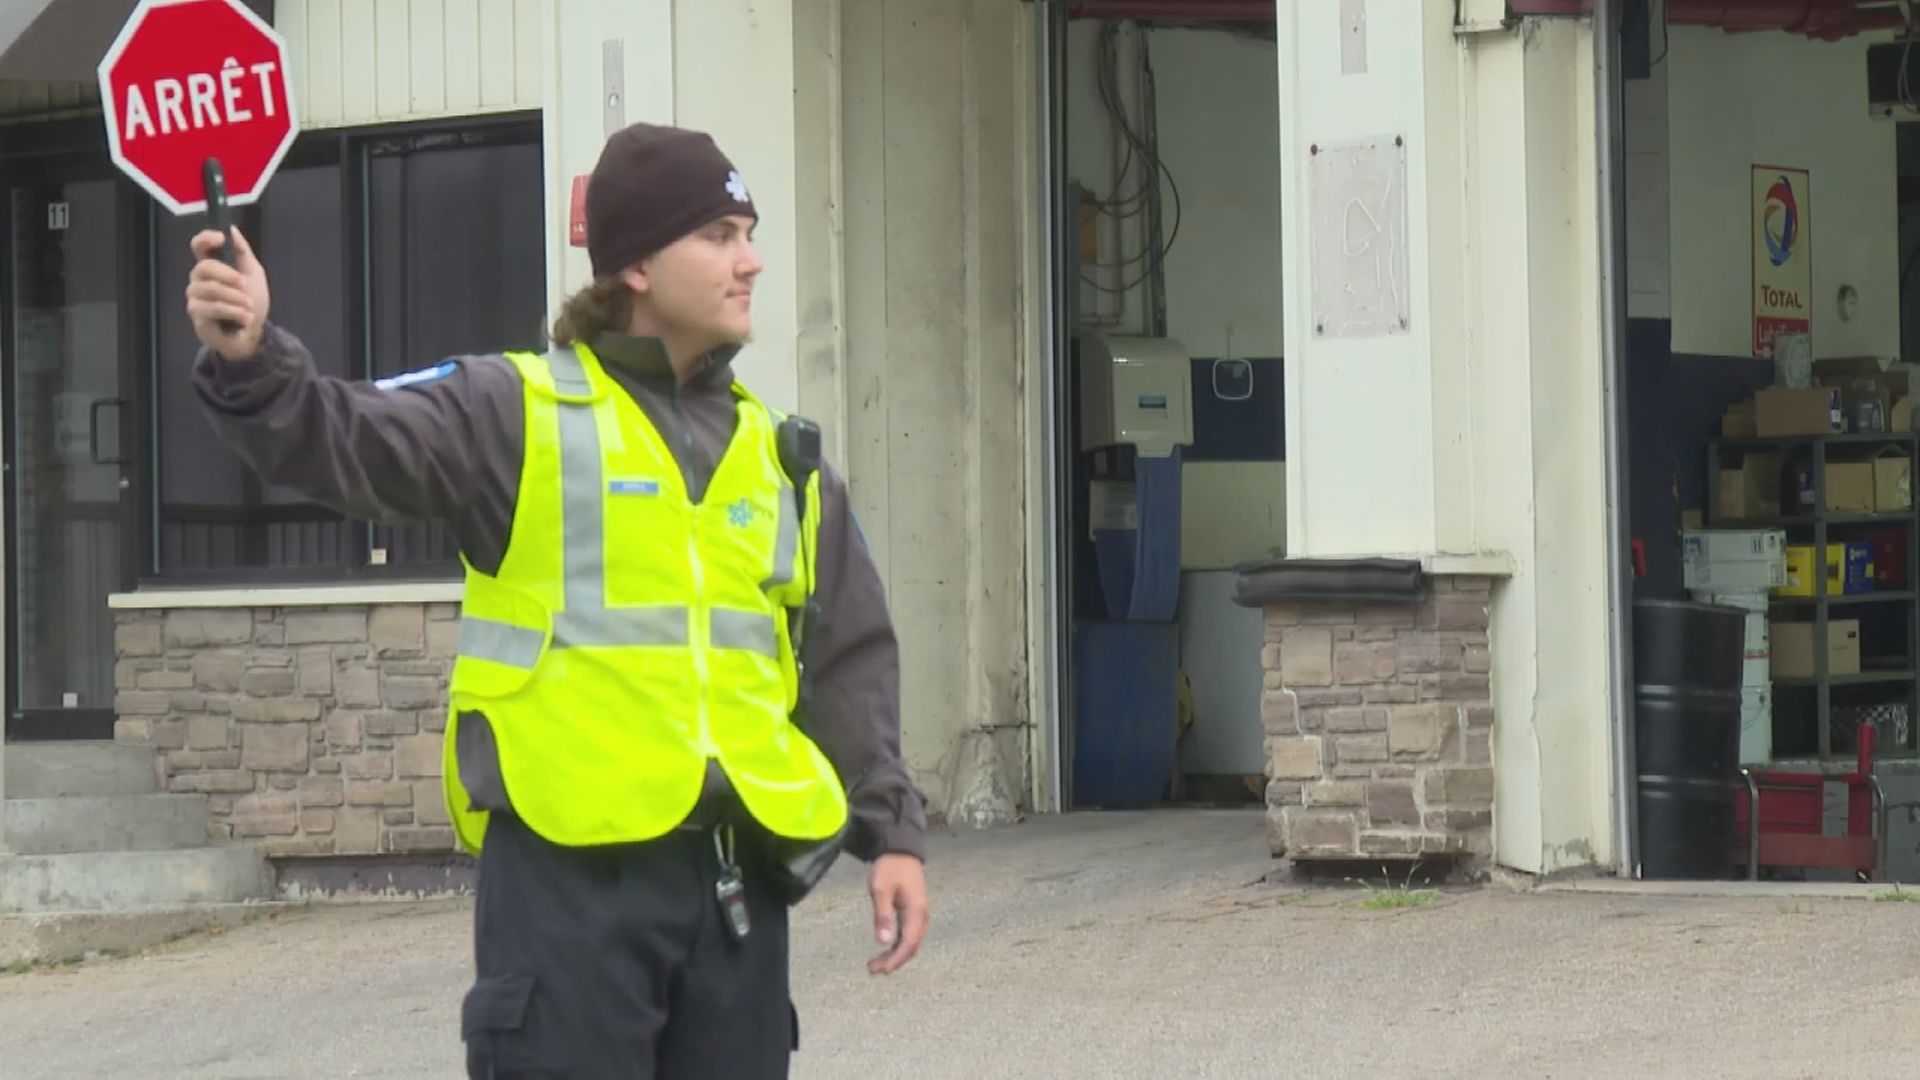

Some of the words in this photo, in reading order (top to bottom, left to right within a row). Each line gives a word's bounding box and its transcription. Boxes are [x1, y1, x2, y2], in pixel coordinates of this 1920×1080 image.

[125, 56, 276, 141] ARRÊT
[50, 205, 66, 226] 11
[1761, 284, 1803, 309] TOTAL
